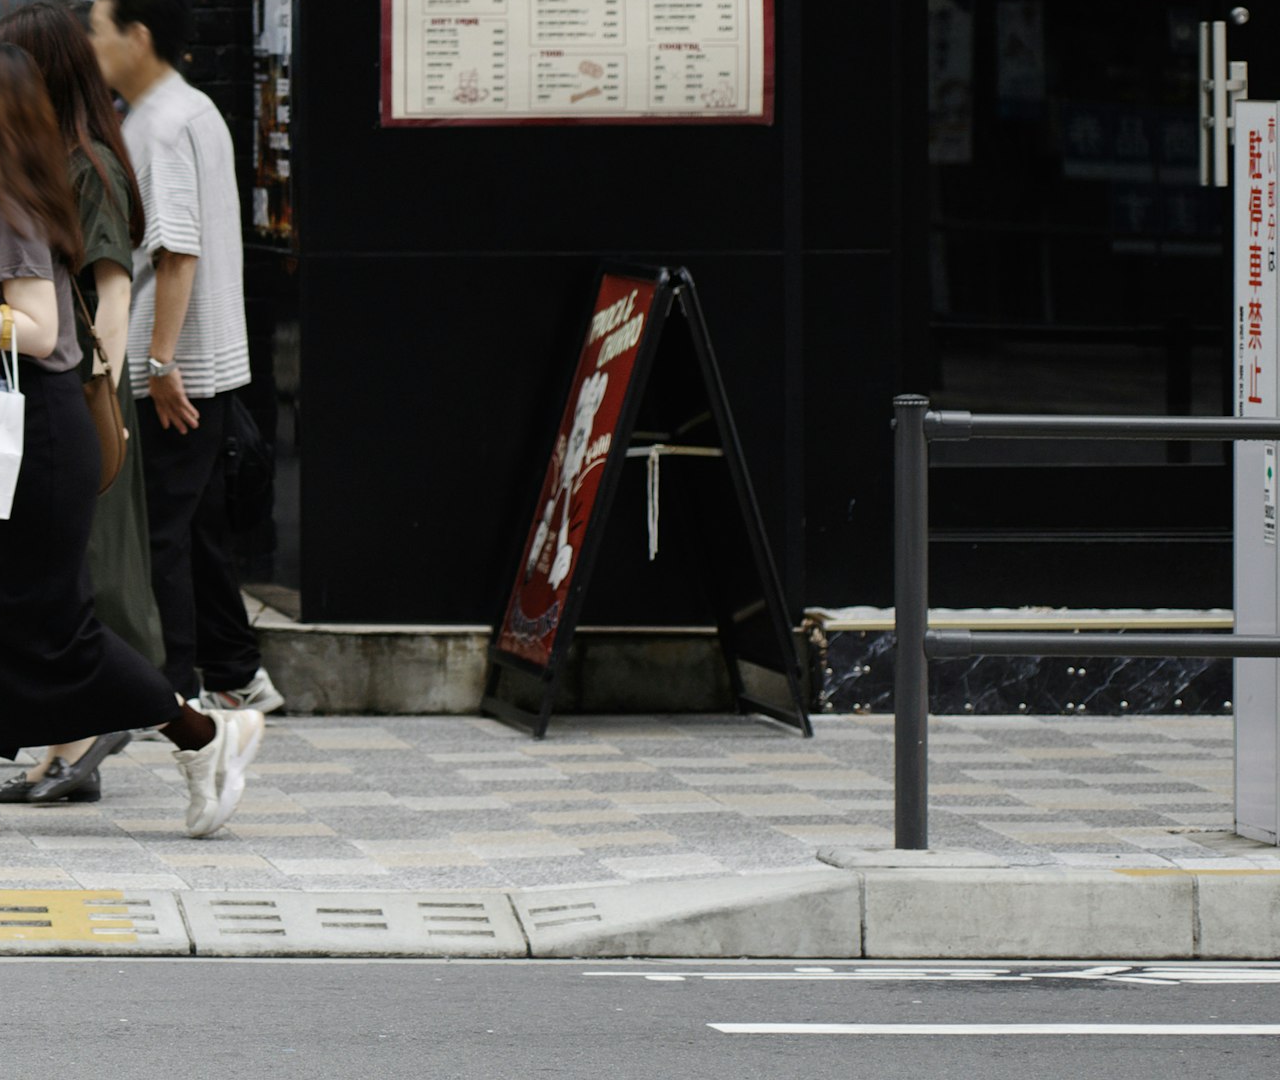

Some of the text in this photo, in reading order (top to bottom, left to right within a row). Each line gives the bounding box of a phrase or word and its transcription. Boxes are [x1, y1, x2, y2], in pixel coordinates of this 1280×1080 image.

[1248, 129, 1263, 404] 駐停車禁止
